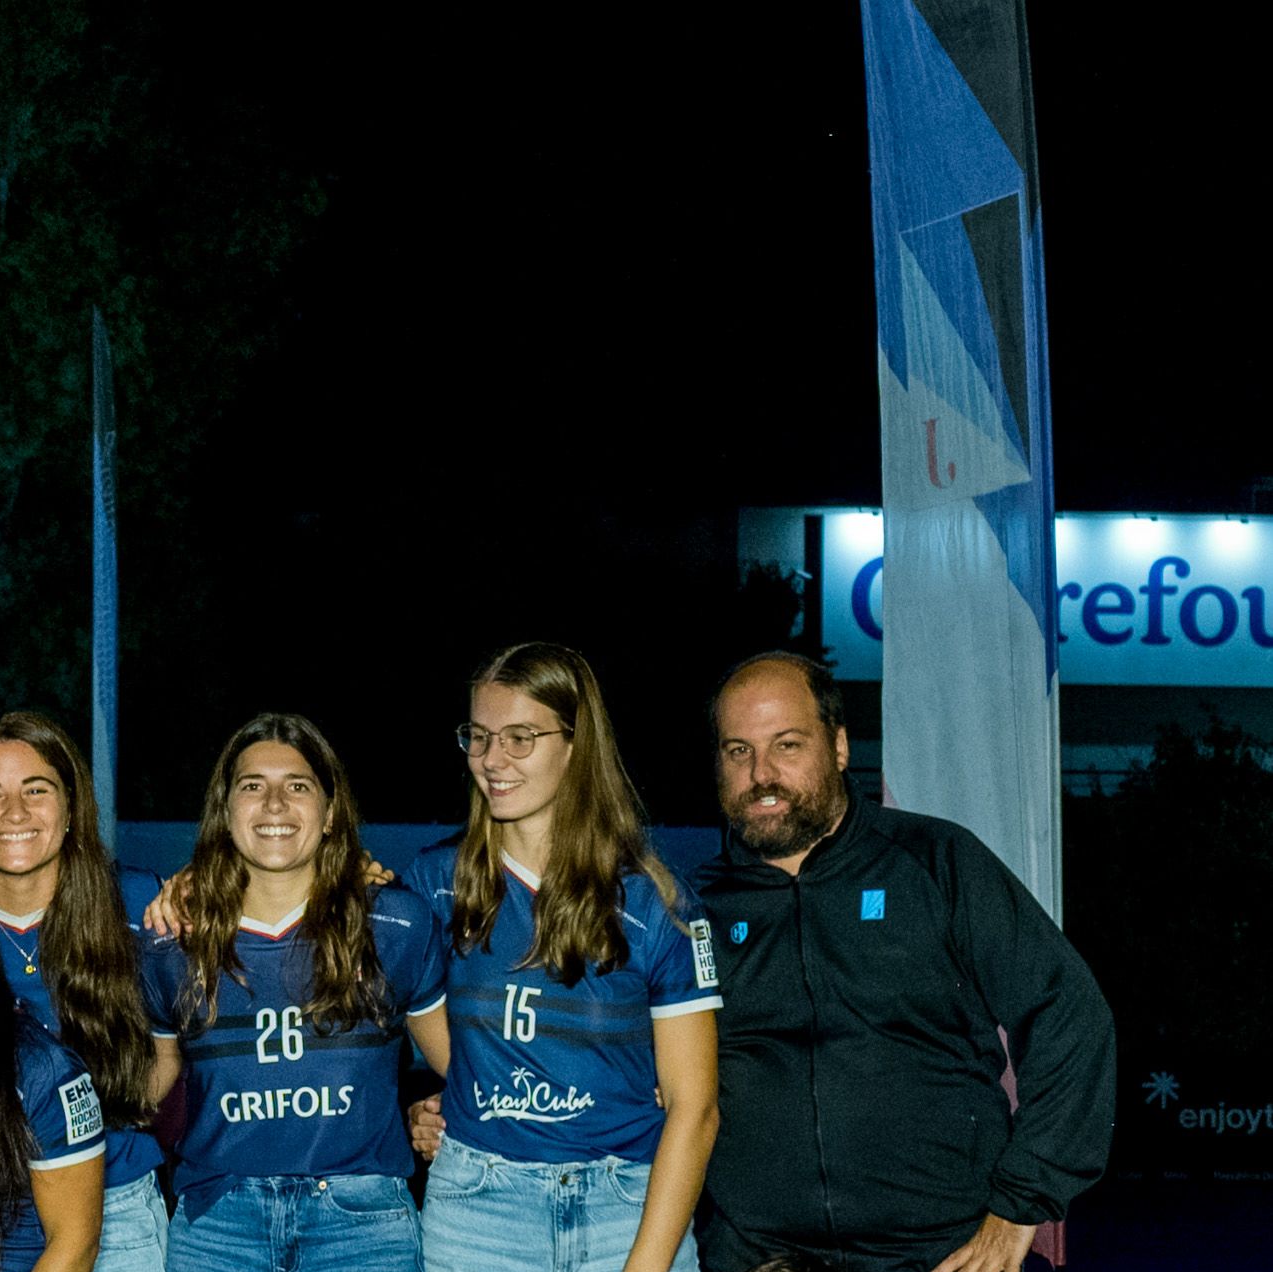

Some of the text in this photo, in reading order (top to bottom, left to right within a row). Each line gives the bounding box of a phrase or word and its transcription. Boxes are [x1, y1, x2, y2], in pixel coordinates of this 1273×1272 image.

[504, 984, 542, 1043] 15
[255, 1005, 304, 1064] 26
[65, 1079, 93, 1104] EHL
[69, 1096, 92, 1116] EURO
[220, 1084, 354, 1123] GRIFOLS
[532, 1081, 595, 1112] Cuba
